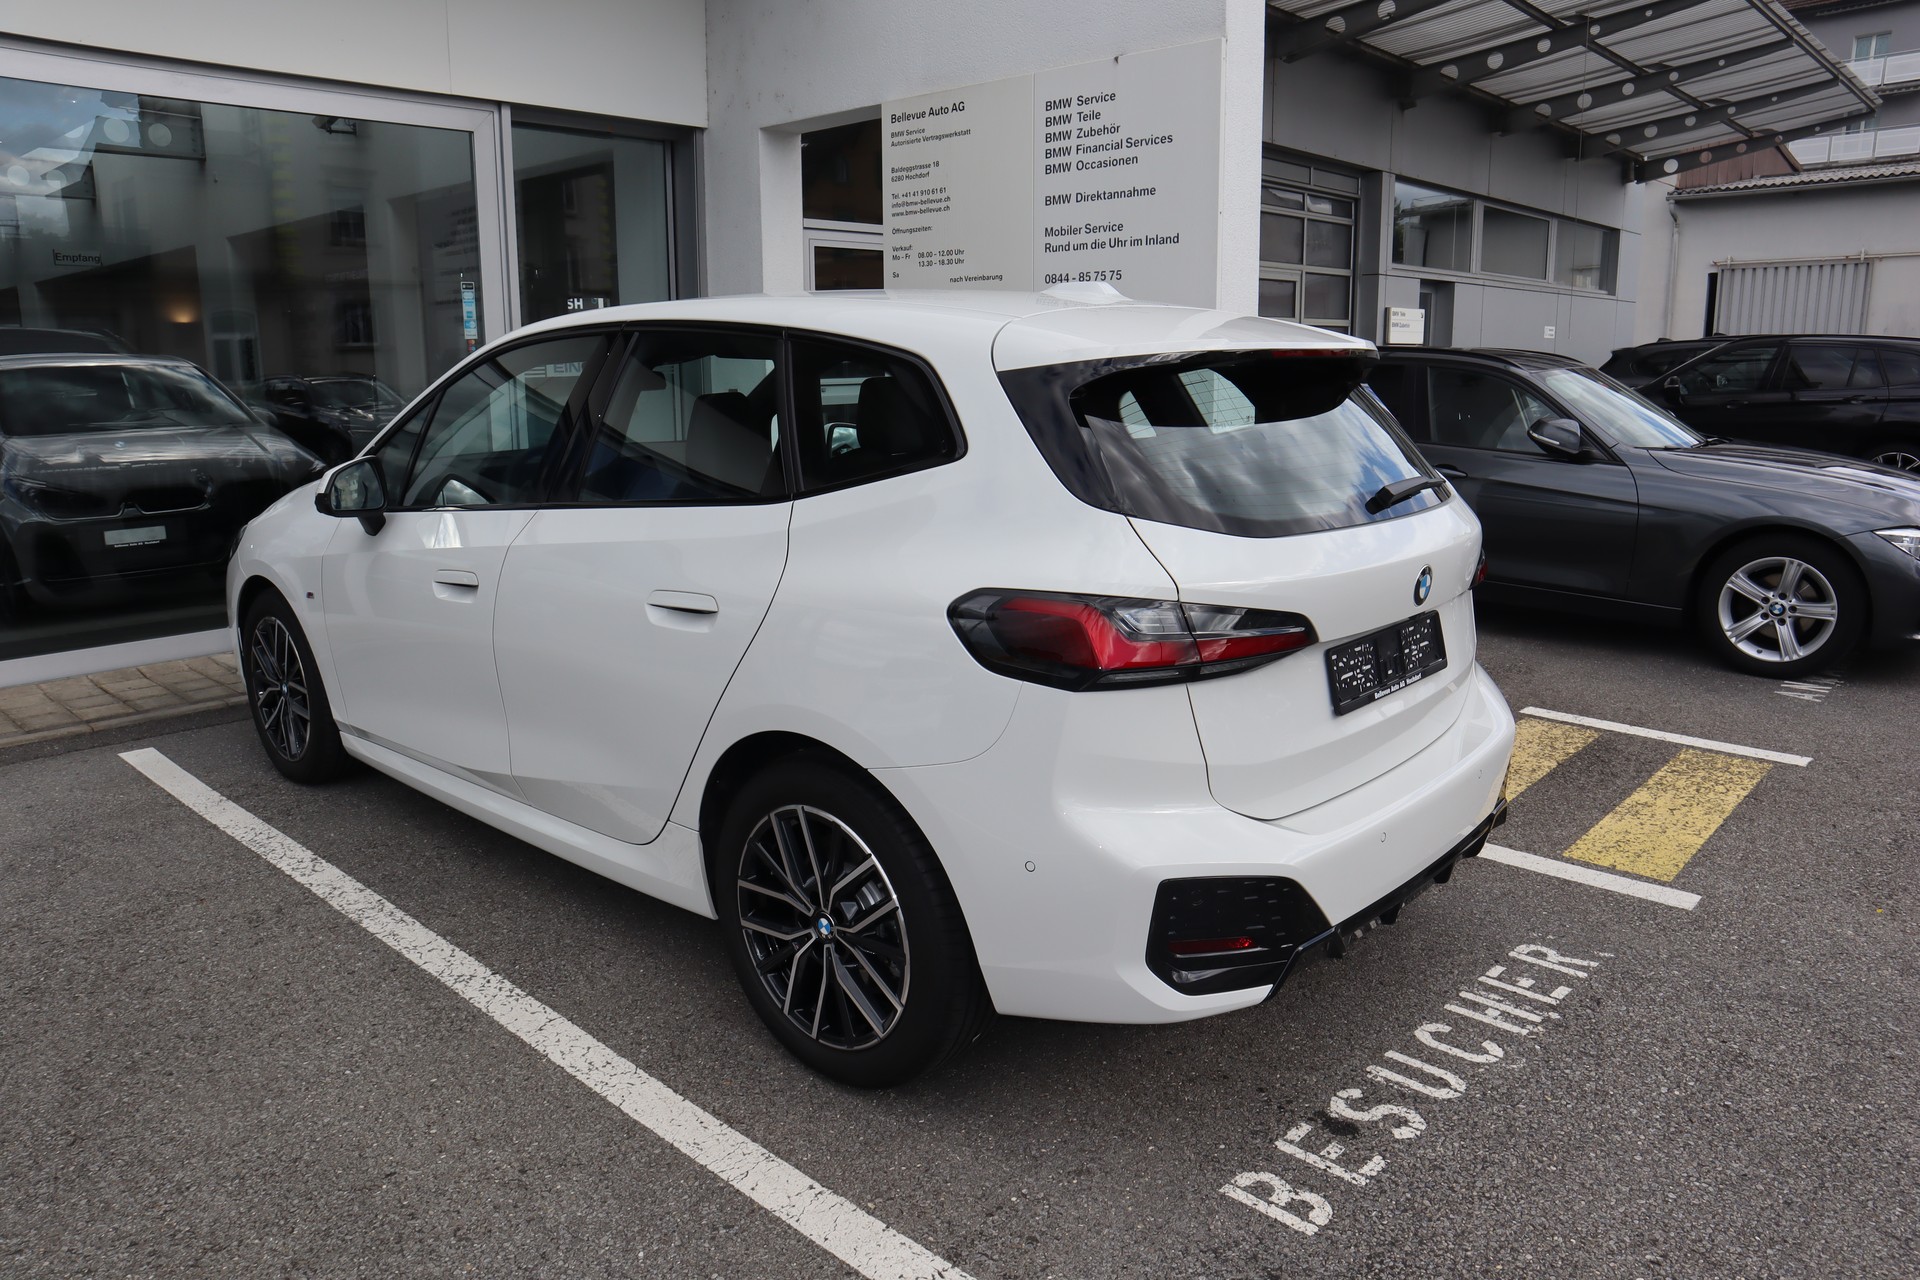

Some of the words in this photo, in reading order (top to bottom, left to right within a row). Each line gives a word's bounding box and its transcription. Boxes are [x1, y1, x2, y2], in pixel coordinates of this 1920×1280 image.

[1045, 97, 1072, 111] BMW
[1077, 92, 1116, 106] Service
[891, 110, 926, 124] Bellevue
[928, 105, 949, 117] Auto
[951, 101, 965, 112] AG
[1045, 113, 1072, 127] BMW
[1077, 110, 1101, 122] Teile
[891, 130, 905, 138] BMW
[906, 127, 925, 137] Service
[891, 137, 921, 147] Autorisierte
[922, 129, 971, 142] Vertragswerkstatt
[1045, 130, 1072, 143] BMW
[1076, 123, 1120, 139] Zubehör
[1045, 146, 1072, 159] BMW
[1076, 139, 1123, 155] Financial
[1125, 134, 1173, 148] Services
[891, 163, 931, 174] Baldeggstrasse
[1045, 162, 1072, 175] BMW
[1076, 156, 1138, 171] Occasionen
[905, 171, 930, 181] Hochdorf
[891, 196, 951, 209] info@bmw-bellevue.ch
[1045, 193, 1071, 206] BMW
[1075, 186, 1156, 203] Direktannahme
[891, 205, 950, 218] www.bmw-bellevue.ch
[892, 225, 933, 235] Öffnungszeiten:
[1044, 225, 1082, 237] Mobiler
[1085, 222, 1124, 235] Service
[1044, 241, 1070, 253] Rund
[1072, 243, 1088, 251] um
[1090, 239, 1106, 250] die
[1108, 237, 1128, 249] Uhr
[1130, 236, 1142, 247] im
[1145, 233, 1180, 246] Inland
[55, 252, 101, 264] Empfang
[917, 251, 933, 259] 08.00
[938, 249, 953, 257] 12.00
[954, 248, 965, 256] Uhr
[918, 260, 933, 268] 13.30
[938, 258, 953, 266] 18.30
[954, 257, 965, 265] Uhr
[949, 275, 963, 283] nach
[964, 274, 1003, 283] Vereinbarung
[1044, 273, 1070, 284] 0844
[1078, 271, 1091, 282] 85
[1094, 270, 1106, 281] 75
[1109, 269, 1122, 280] 75
[554, 362, 585, 374] EIN
[1218, 944, 1600, 1236] BESUCHER
